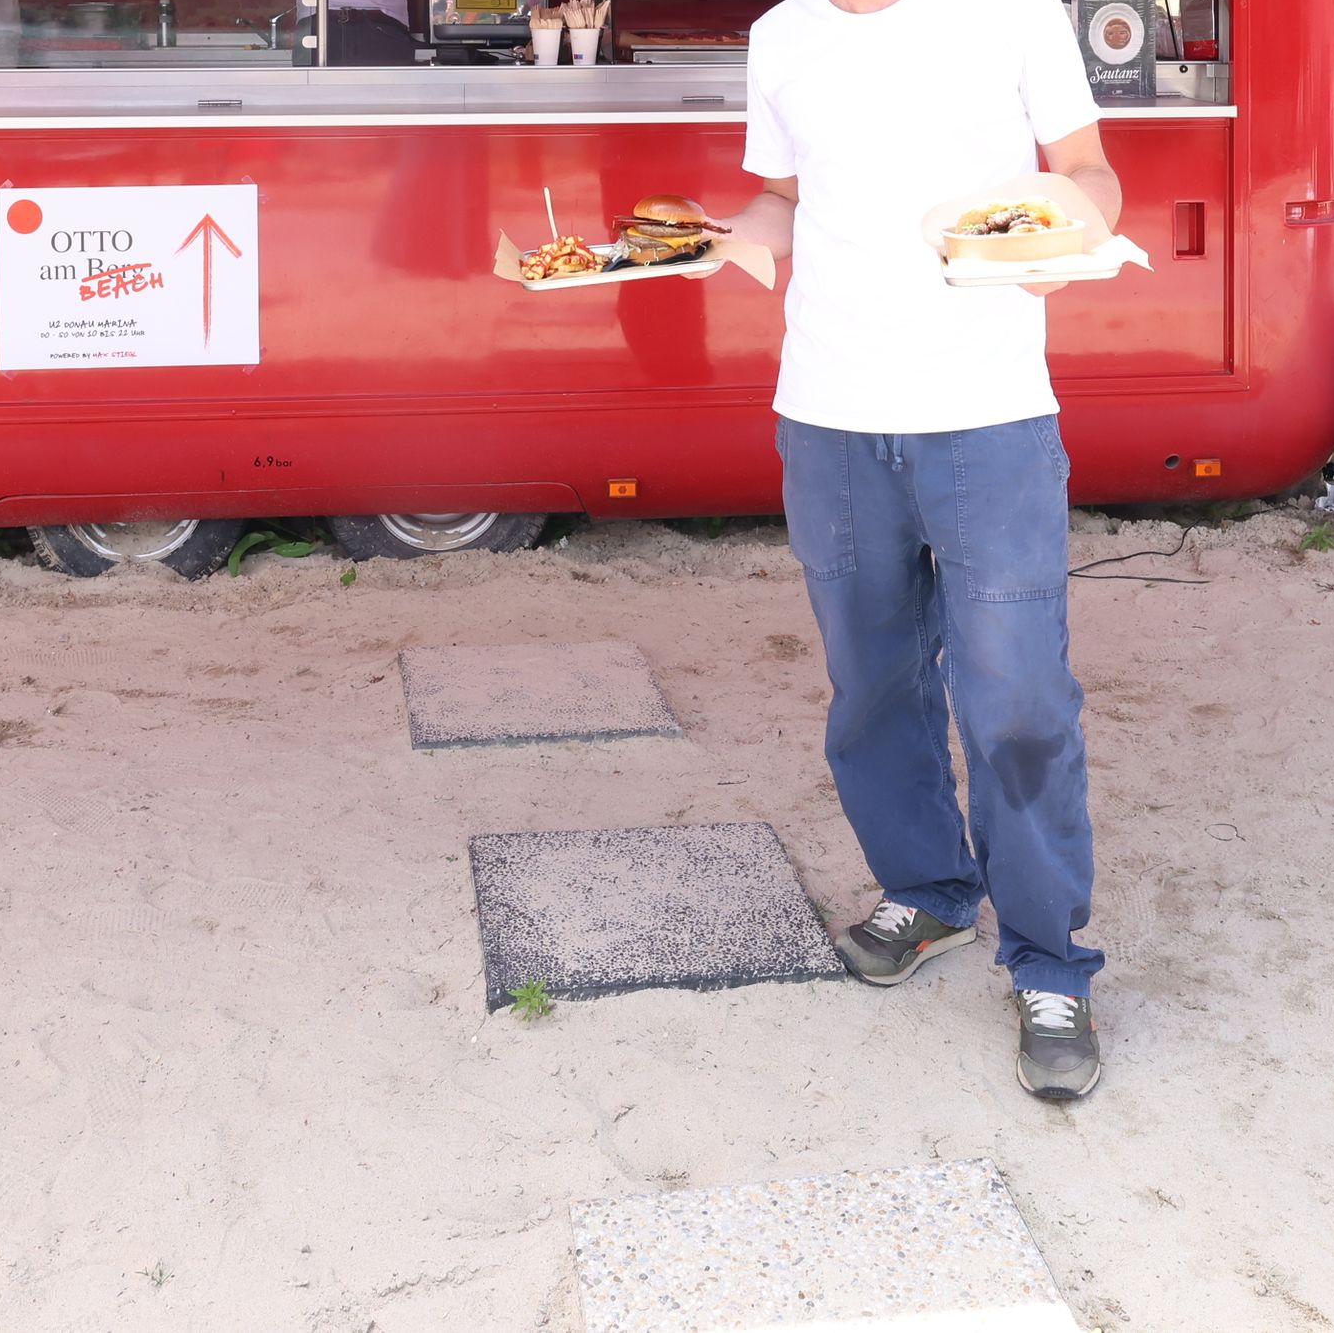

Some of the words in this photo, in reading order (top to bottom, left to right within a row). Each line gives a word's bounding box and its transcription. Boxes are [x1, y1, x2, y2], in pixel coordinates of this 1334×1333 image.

[1090, 66, 1140, 84] Sautanz
[51, 230, 133, 253] OTTO
[40, 264, 76, 281] am
[79, 272, 164, 301] BEACH
[49, 320, 61, 328] U2
[64, 319, 95, 329] DONAU
[98, 319, 138, 328] MARINA
[87, 330, 98, 338] 10
[100, 330, 115, 338] BIS
[118, 329, 128, 337] 22
[254, 455, 274, 468] 6,9
[276, 459, 292, 467] bar
